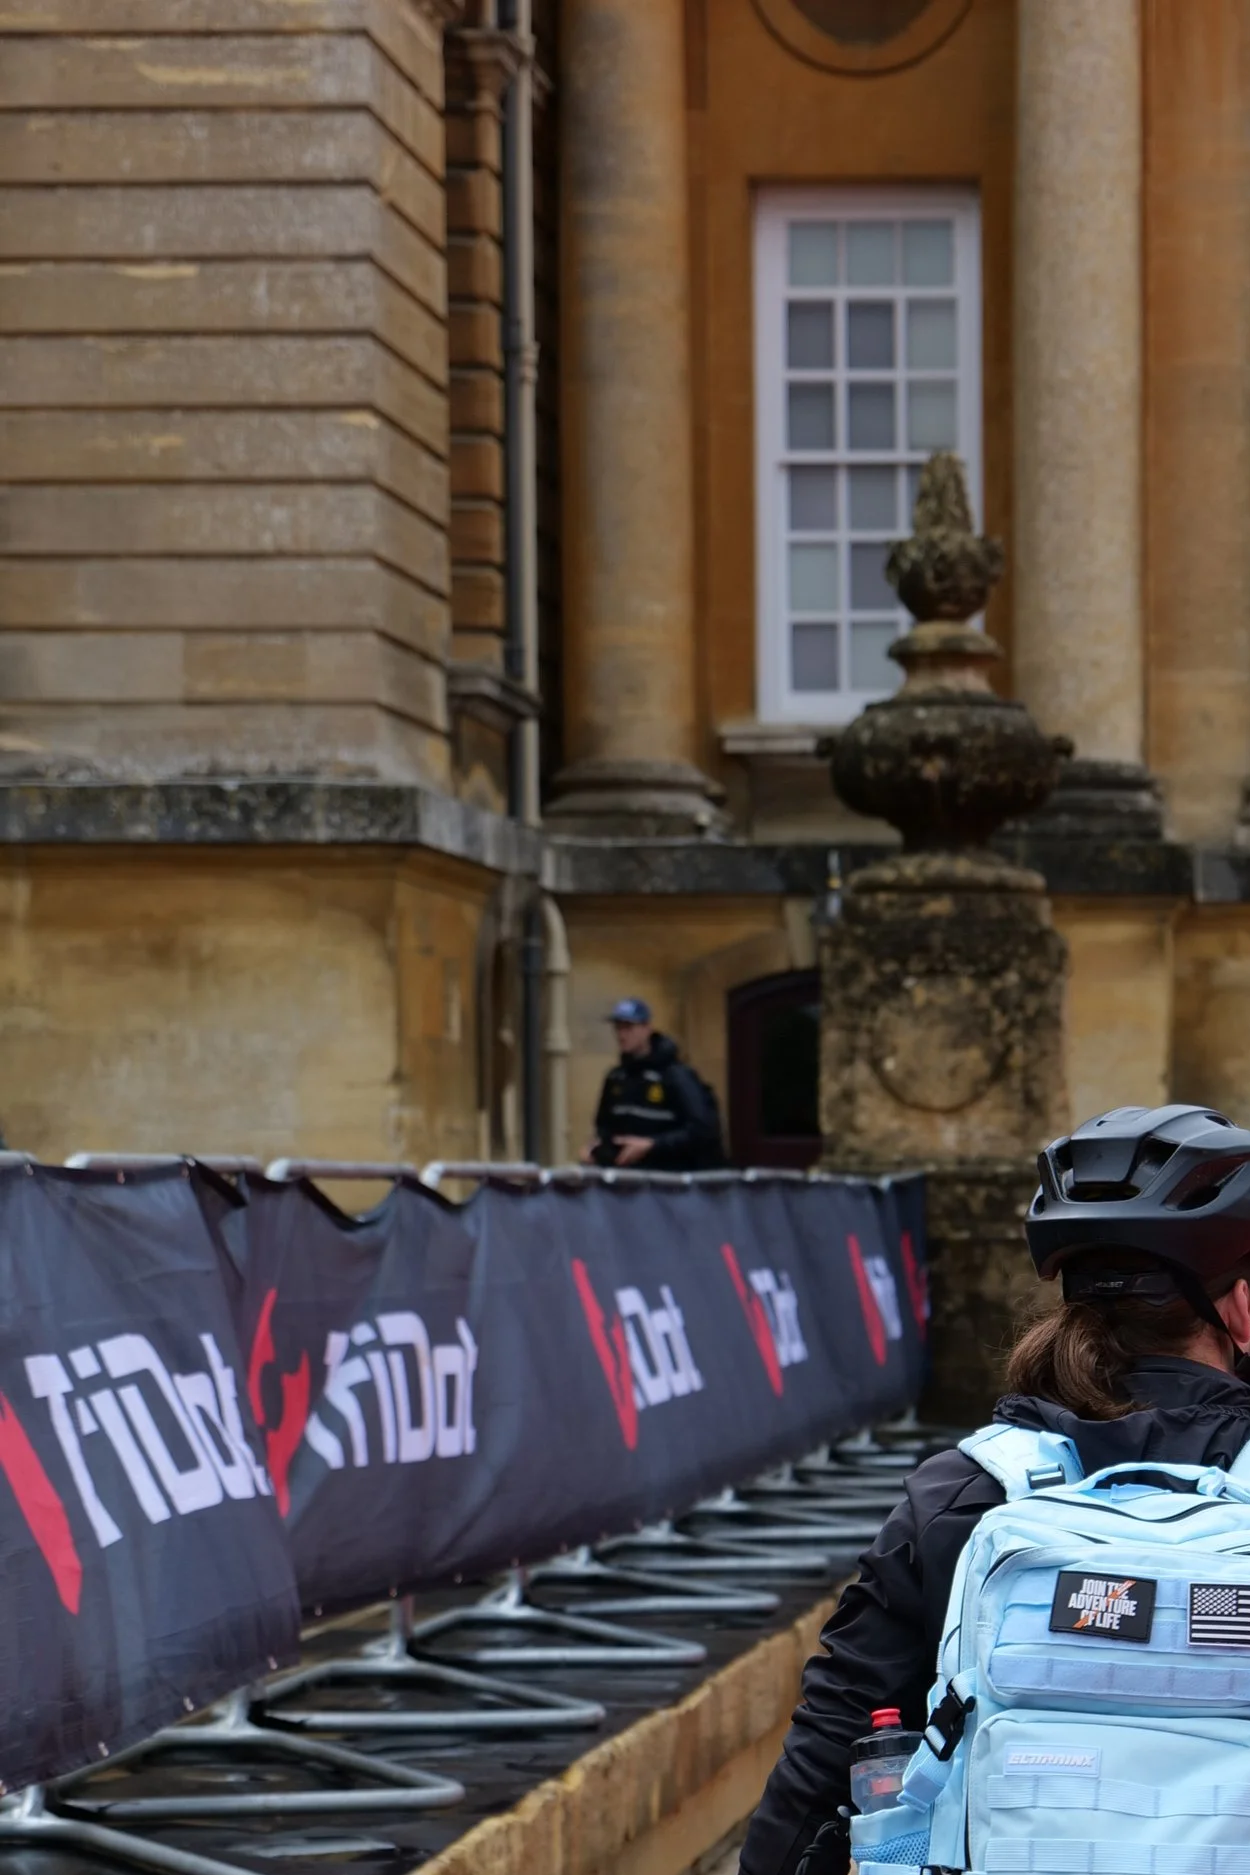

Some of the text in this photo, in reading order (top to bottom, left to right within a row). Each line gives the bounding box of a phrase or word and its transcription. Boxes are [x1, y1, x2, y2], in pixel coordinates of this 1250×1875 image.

[23, 1333, 274, 1548] TriDot
[1080, 1579, 1106, 1595] JOIN
[1067, 1593, 1138, 1617] ADVENTURE
[1095, 1612, 1121, 1630] LIFE
